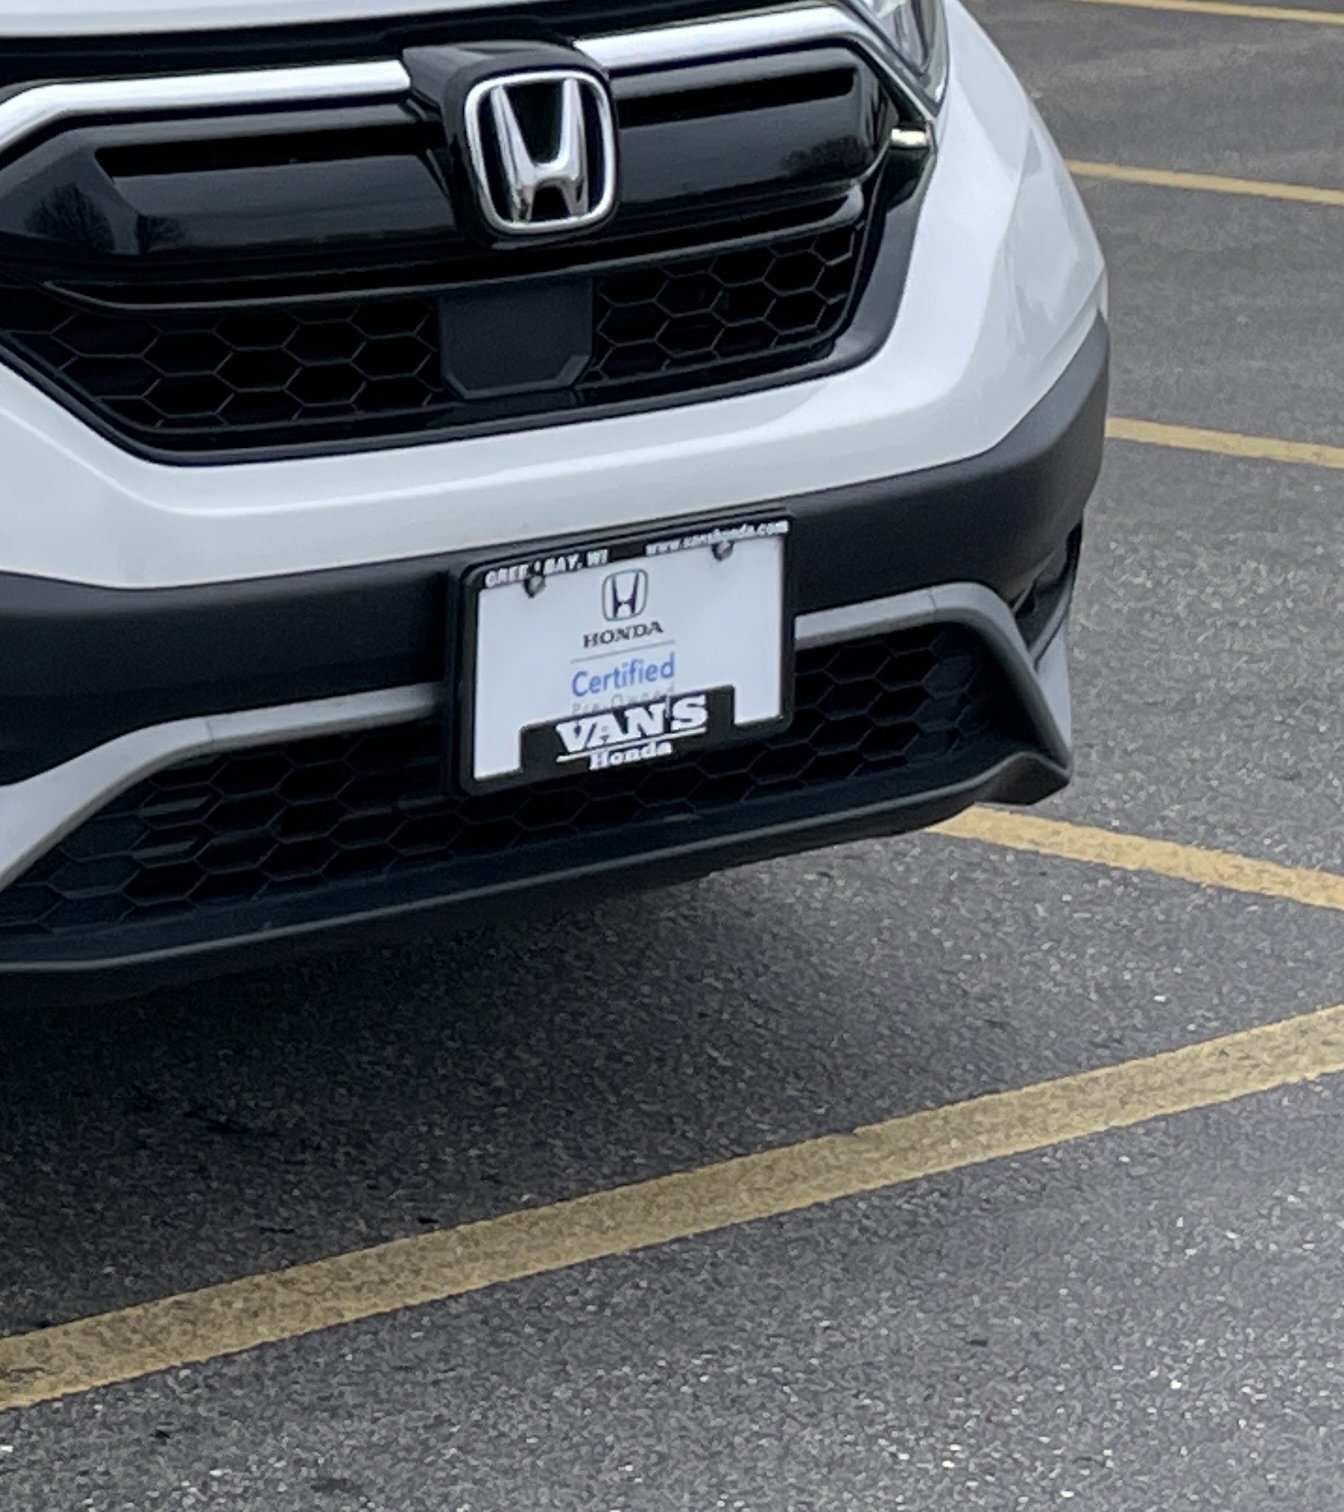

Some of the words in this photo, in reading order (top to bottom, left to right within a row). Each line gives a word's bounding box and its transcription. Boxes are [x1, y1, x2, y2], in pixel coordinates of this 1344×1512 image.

[582, 620, 664, 649] HONDA
[571, 650, 675, 698] Certified
[588, 740, 673, 771] Honda
